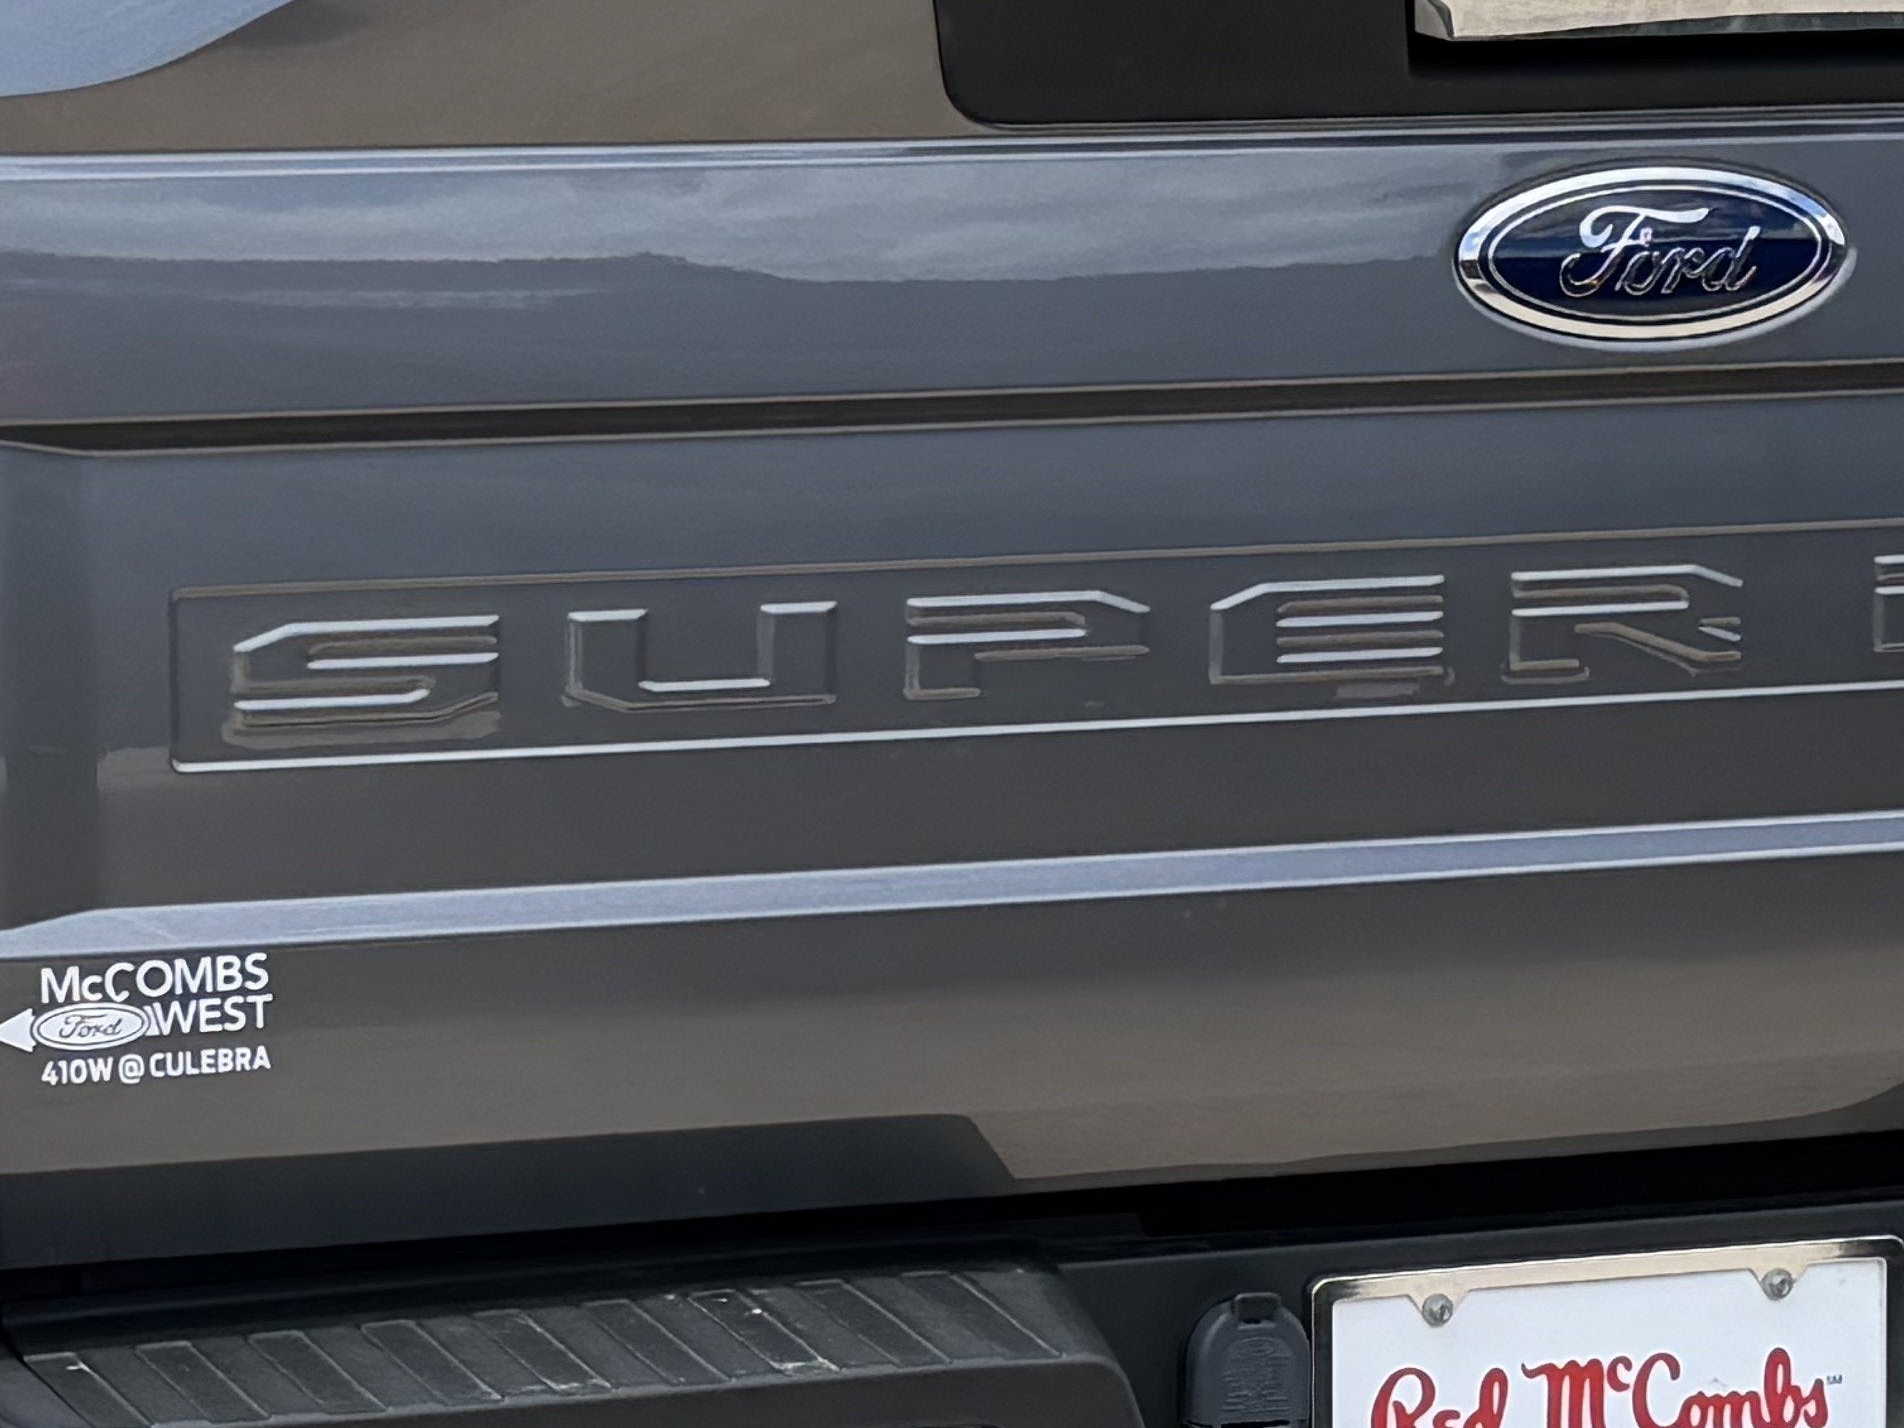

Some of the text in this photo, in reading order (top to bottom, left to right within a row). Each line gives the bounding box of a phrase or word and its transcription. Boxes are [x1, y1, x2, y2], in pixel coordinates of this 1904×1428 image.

[1559, 204, 1761, 298] Ford
[232, 564, 1744, 734] SUPER
[40, 952, 270, 1004] McCOMBS
[58, 992, 274, 1039] Ford WEST
